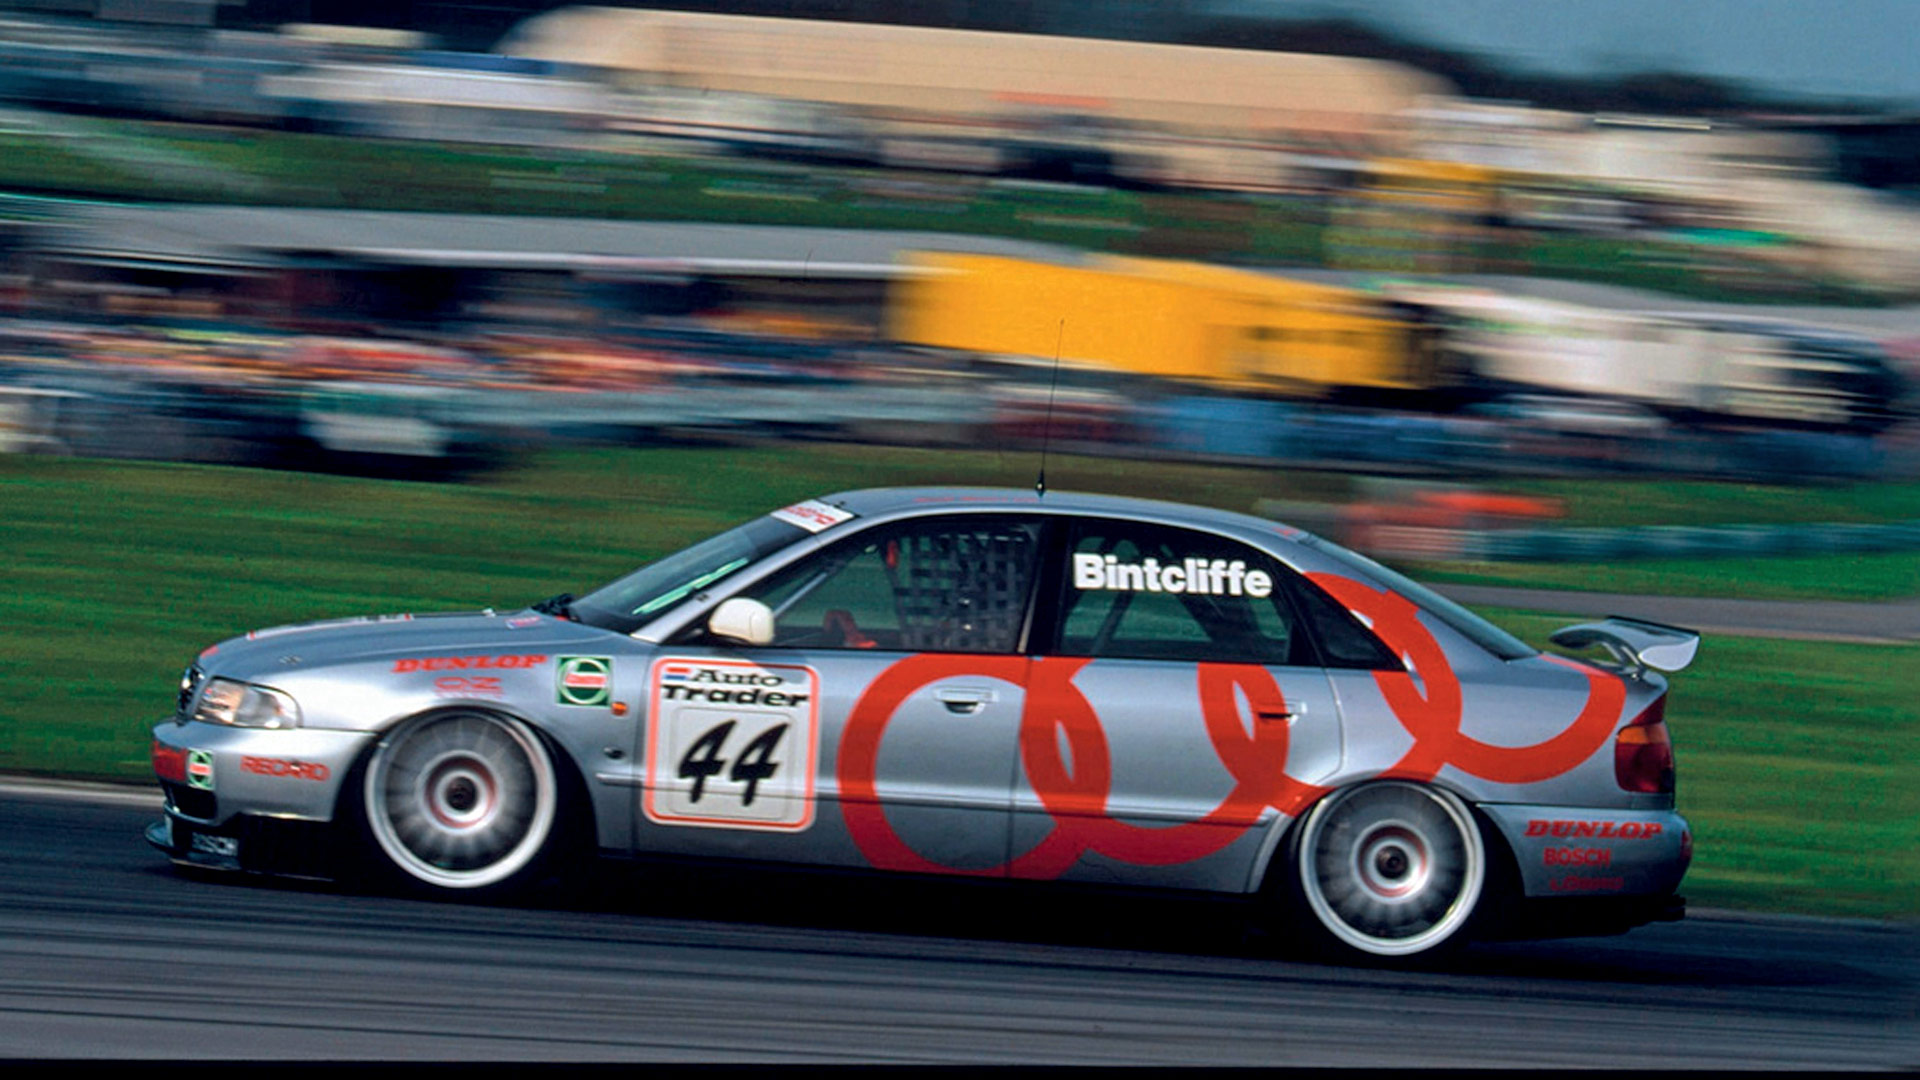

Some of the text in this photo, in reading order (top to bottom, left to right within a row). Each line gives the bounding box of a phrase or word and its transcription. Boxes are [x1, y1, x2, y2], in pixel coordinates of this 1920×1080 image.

[1073, 552, 1273, 598] Bintcliffe
[391, 654, 548, 673] DUNLOP
[690, 669, 785, 687] Auto
[660, 684, 810, 707] Trader
[678, 719, 791, 807] 44
[1524, 819, 1663, 839] DUNLOP
[1543, 847, 1612, 868] BOSCH
